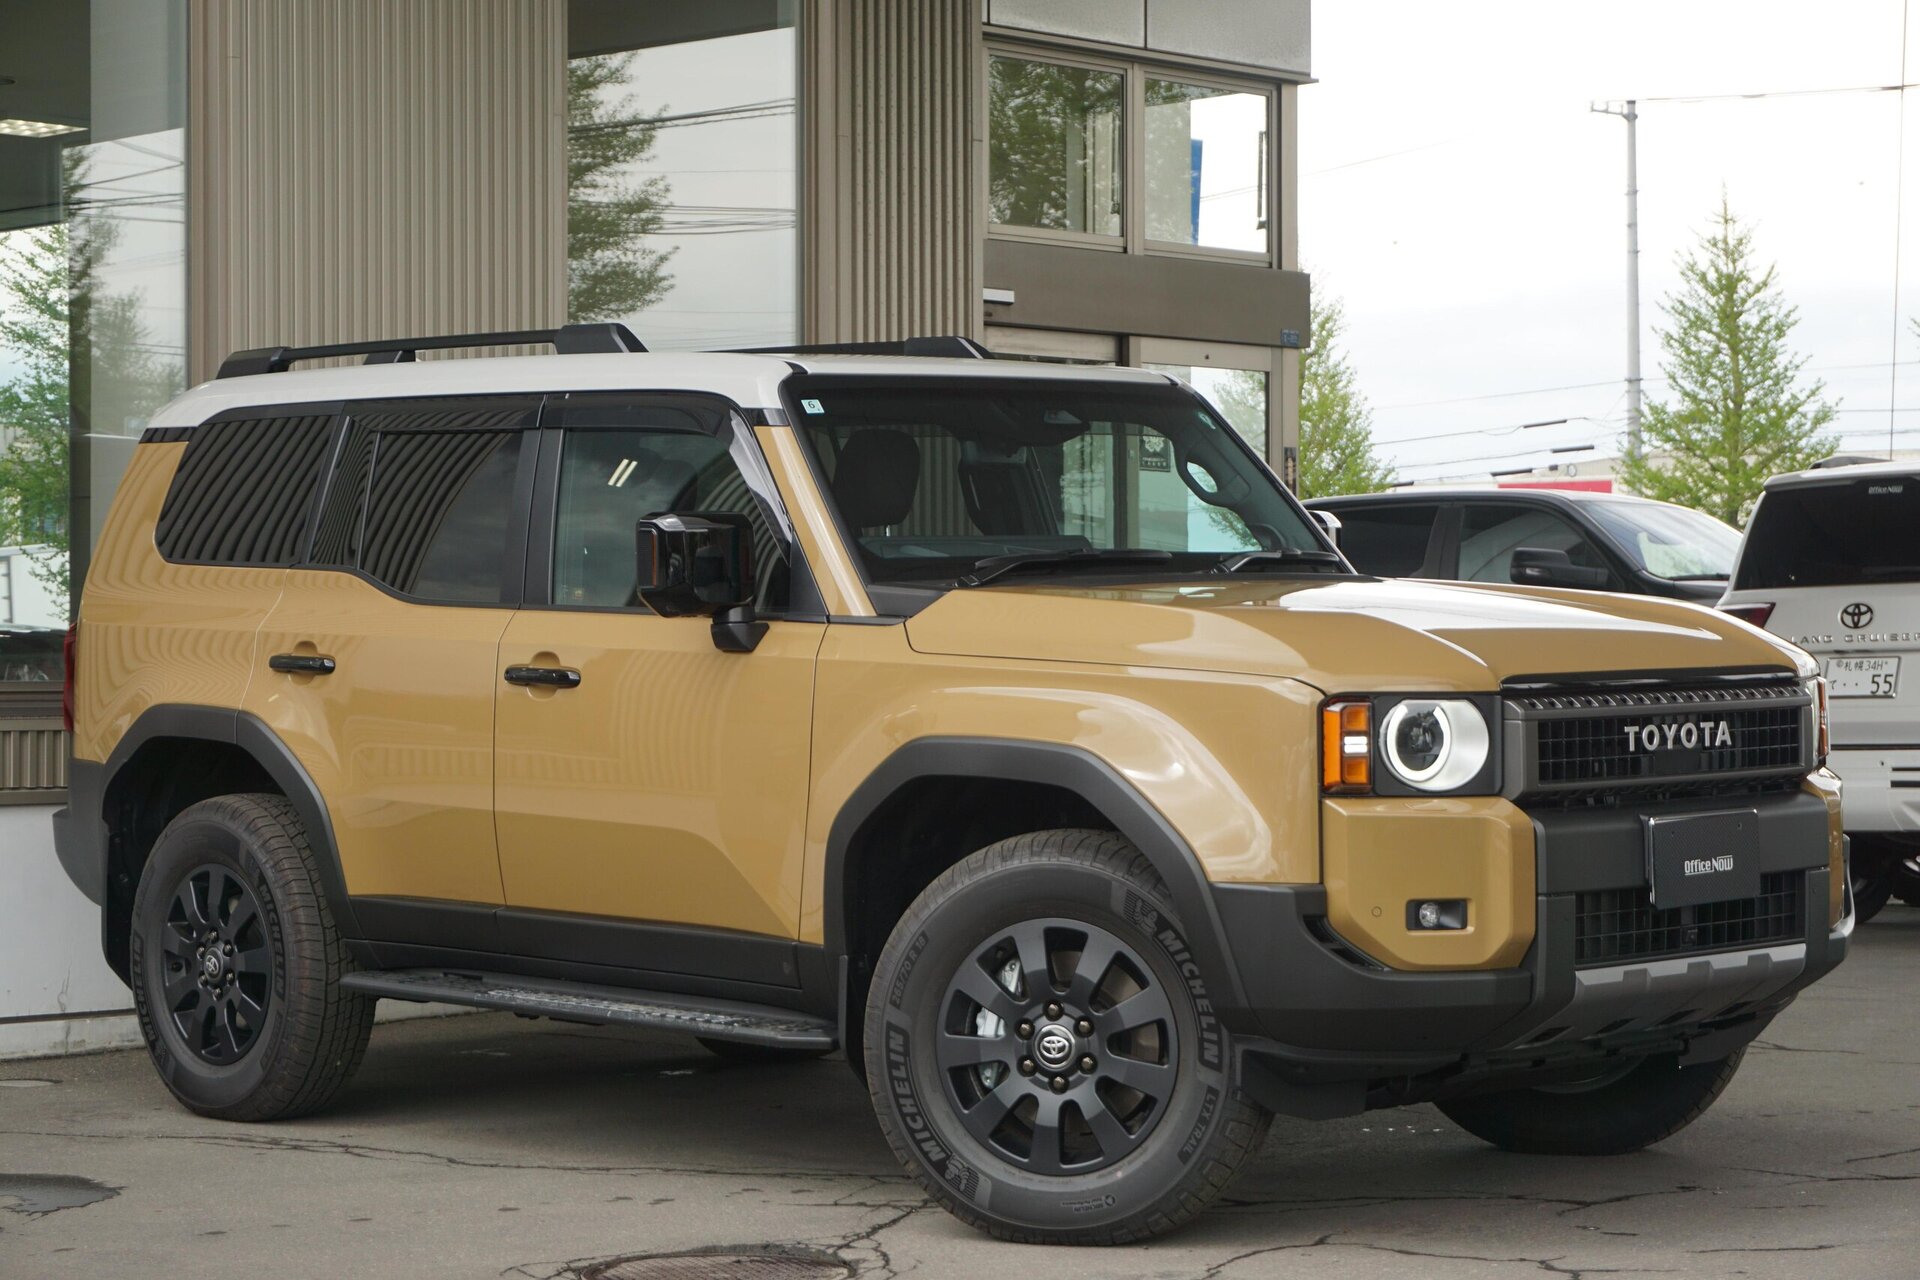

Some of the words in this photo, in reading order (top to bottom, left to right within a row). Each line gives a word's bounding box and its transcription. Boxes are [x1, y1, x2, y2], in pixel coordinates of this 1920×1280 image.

[807, 400, 816, 409] 6
[1791, 634, 1833, 645] LAND
[1870, 674, 1894, 695] 55
[1624, 720, 1732, 752] TOYOTA
[892, 960, 912, 1006] 265/70
[915, 935, 927, 950] 18
[1157, 929, 1220, 1065] MICHELIN
[888, 1030, 947, 1162] MICHELIN
[1201, 1093, 1217, 1120] LTX
[1183, 1122, 1208, 1153] TRAIL
